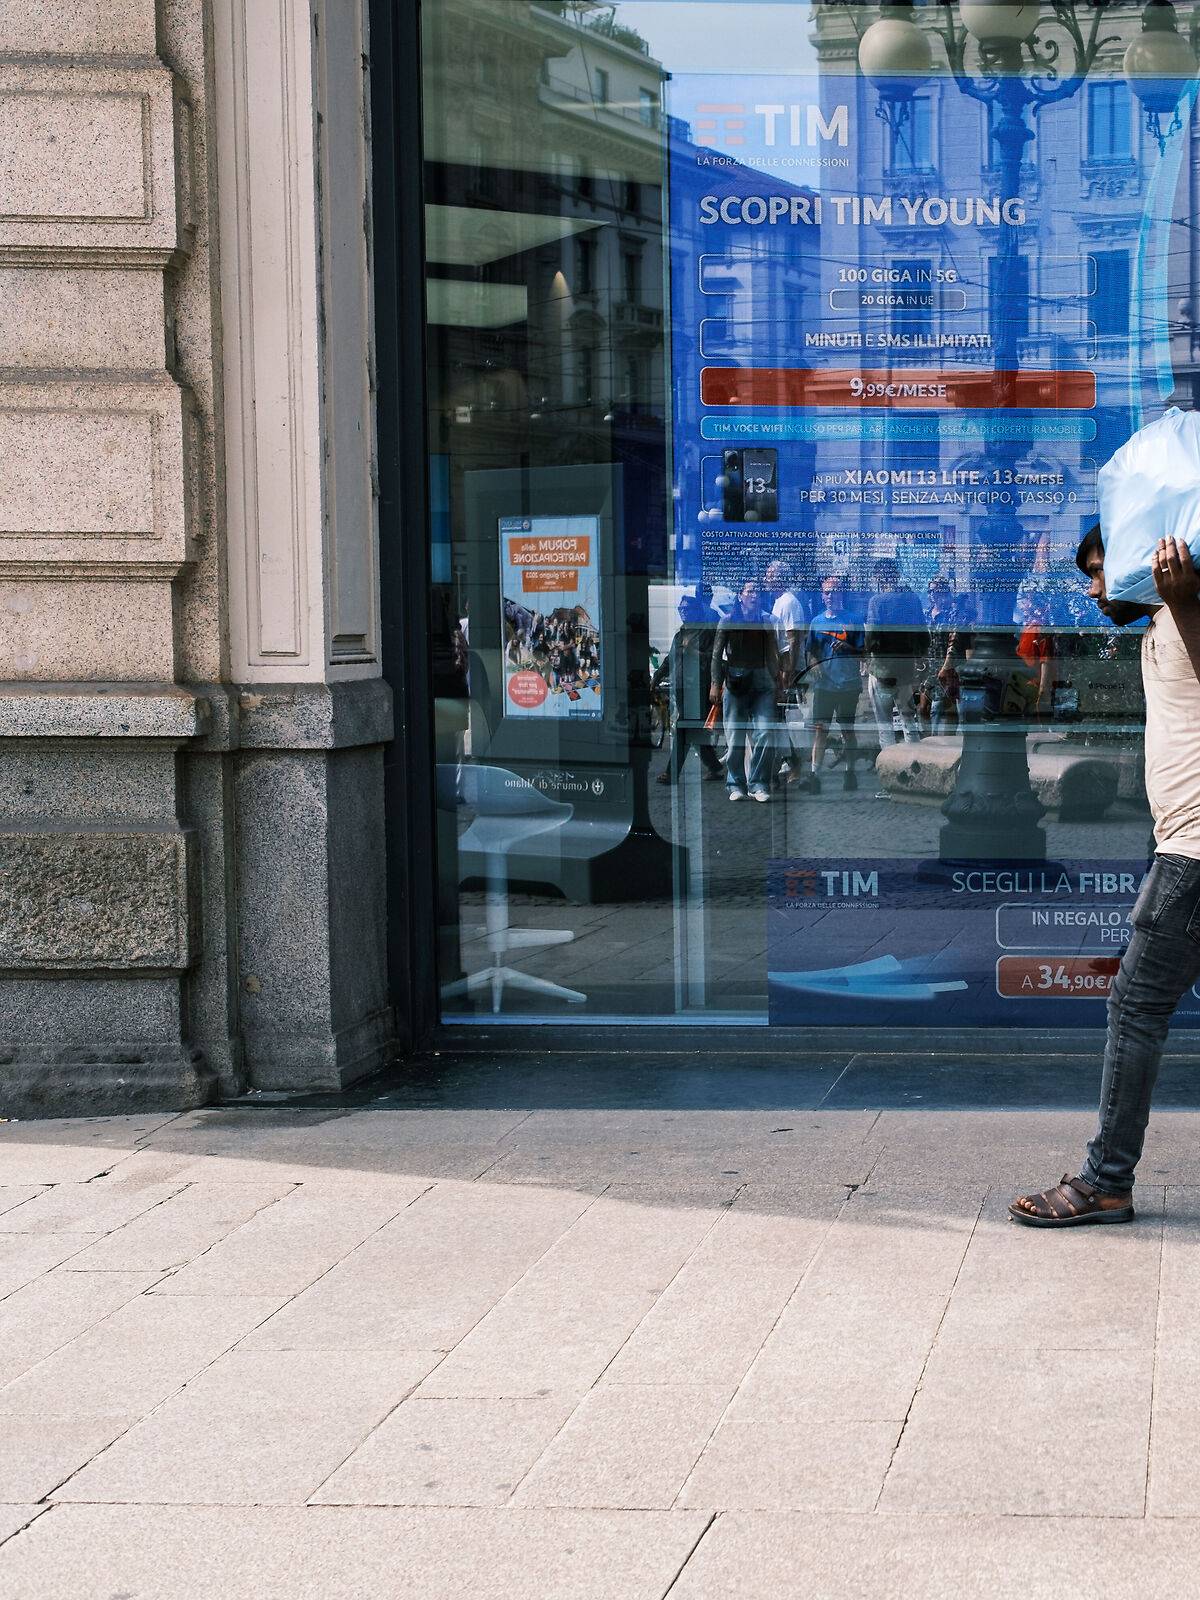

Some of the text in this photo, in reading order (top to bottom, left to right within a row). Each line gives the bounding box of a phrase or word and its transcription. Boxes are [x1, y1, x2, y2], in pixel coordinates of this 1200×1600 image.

[755, 104, 848, 146] TIM
[697, 157, 849, 167] LA FORZA DELLE CONNESSIONI
[699, 195, 1026, 226] SCOPRI TIM YOUNG
[839, 269, 957, 283] 100 GIGA IN 5G
[861, 295, 934, 305] 20 GIGA IN UE
[805, 333, 991, 348] MINUTI E SMS ILLIMITATI
[850, 377, 947, 399] 9,99€/MESE
[713, 424, 731, 433] TIM
[733, 424, 759, 433] VOCE
[812, 475, 823, 485] IN
[844, 470, 912, 485] XIAOMI
[916, 470, 936, 485] 13
[942, 470, 980, 485] LITE
[992, 469, 1064, 486] 13€/MESE
[800, 490, 1077, 506] PER 30 MESI, SENZA ANTICIPO, TASSO 0
[821, 871, 879, 896] TIM
[951, 871, 1033, 894] SCEGLI
[1041, 872, 1072, 894] LA
[1032, 911, 1049, 926] IN
[1054, 911, 1121, 926] REGALO
[1101, 928, 1130, 943] PER
[1021, 965, 1115, 991] A 34,90€/
